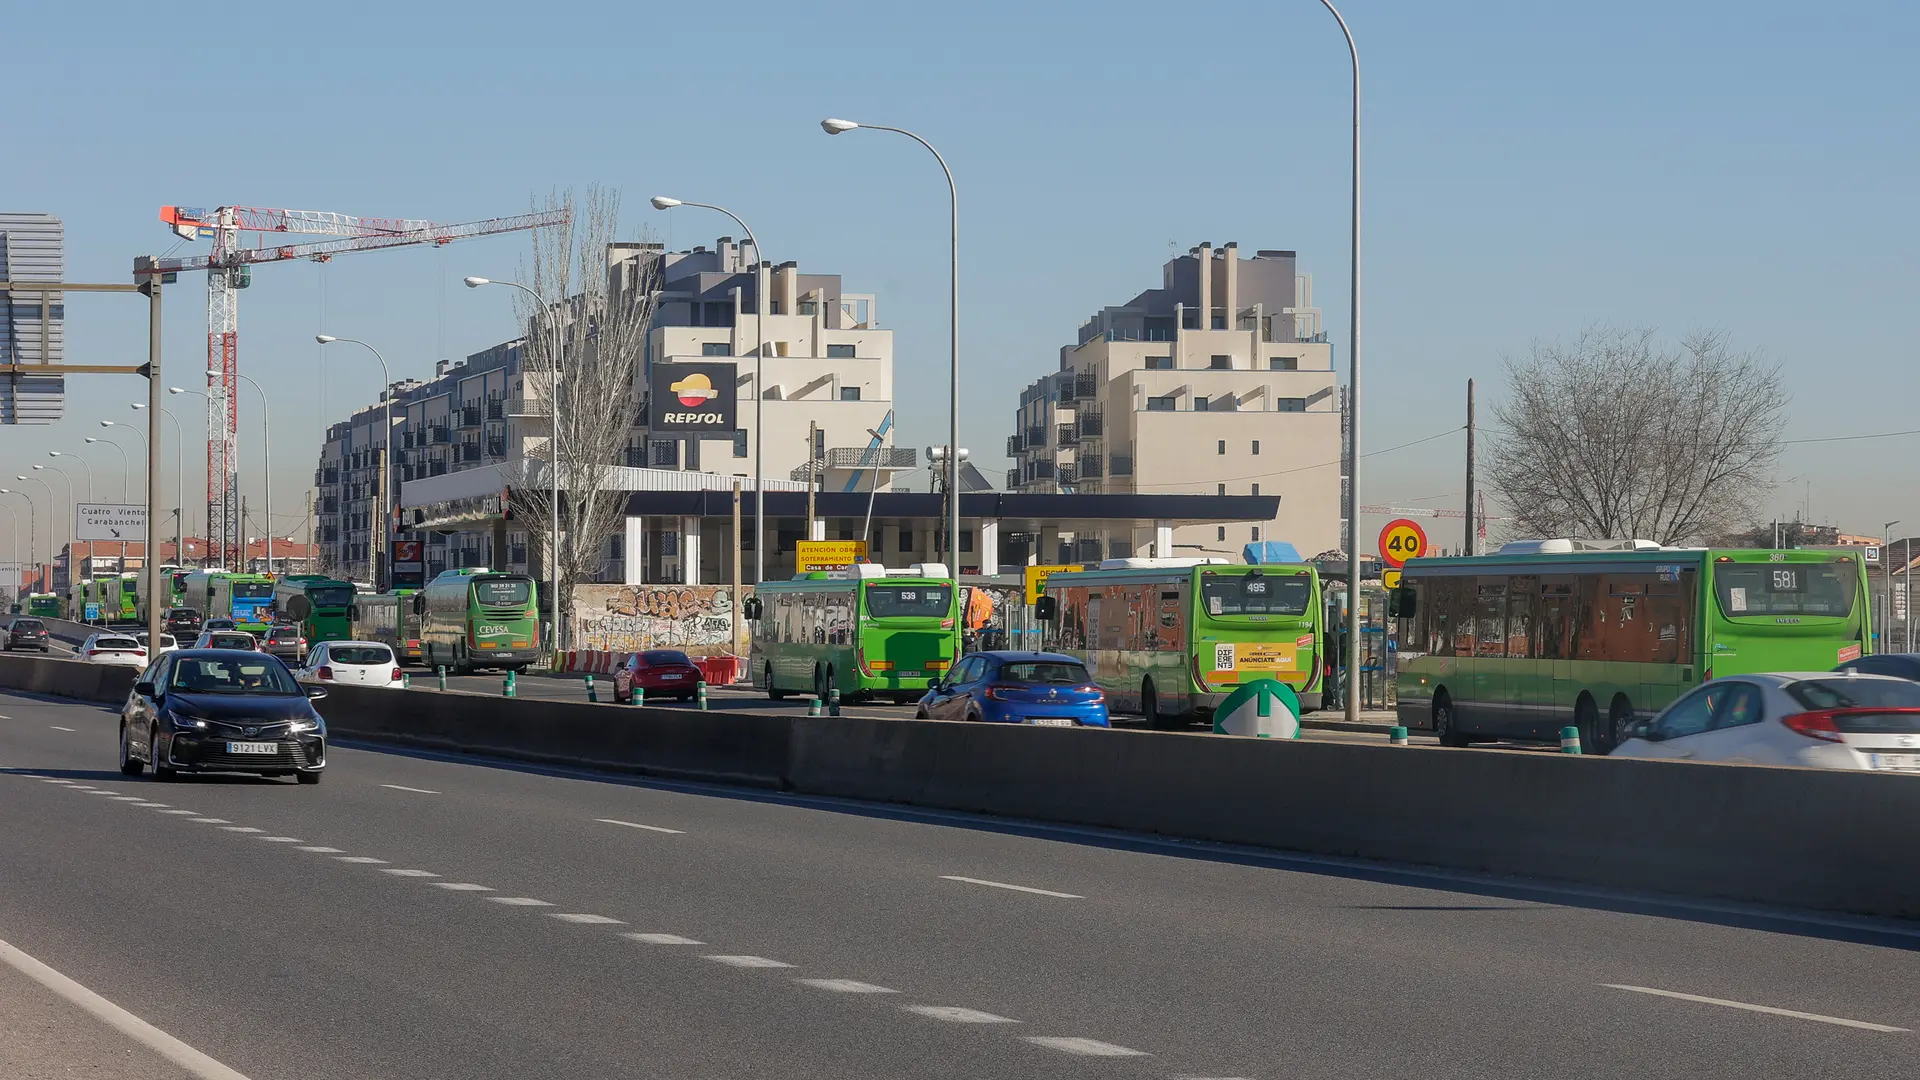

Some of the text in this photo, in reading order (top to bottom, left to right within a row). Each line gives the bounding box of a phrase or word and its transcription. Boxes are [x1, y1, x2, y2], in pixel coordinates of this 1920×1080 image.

[664, 413, 724, 424] REPSOL
[117, 508, 146, 516] Viento
[87, 518, 144, 526] Carabanchel
[1388, 536, 1418, 552] 40
[1656, 565, 1670, 573] GRUPO
[1773, 571, 1797, 588] 581
[1247, 583, 1266, 592] 495
[901, 592, 916, 600] 539
[480, 625, 509, 634] CEVESA
[233, 744, 275, 753] 9121 LVX
